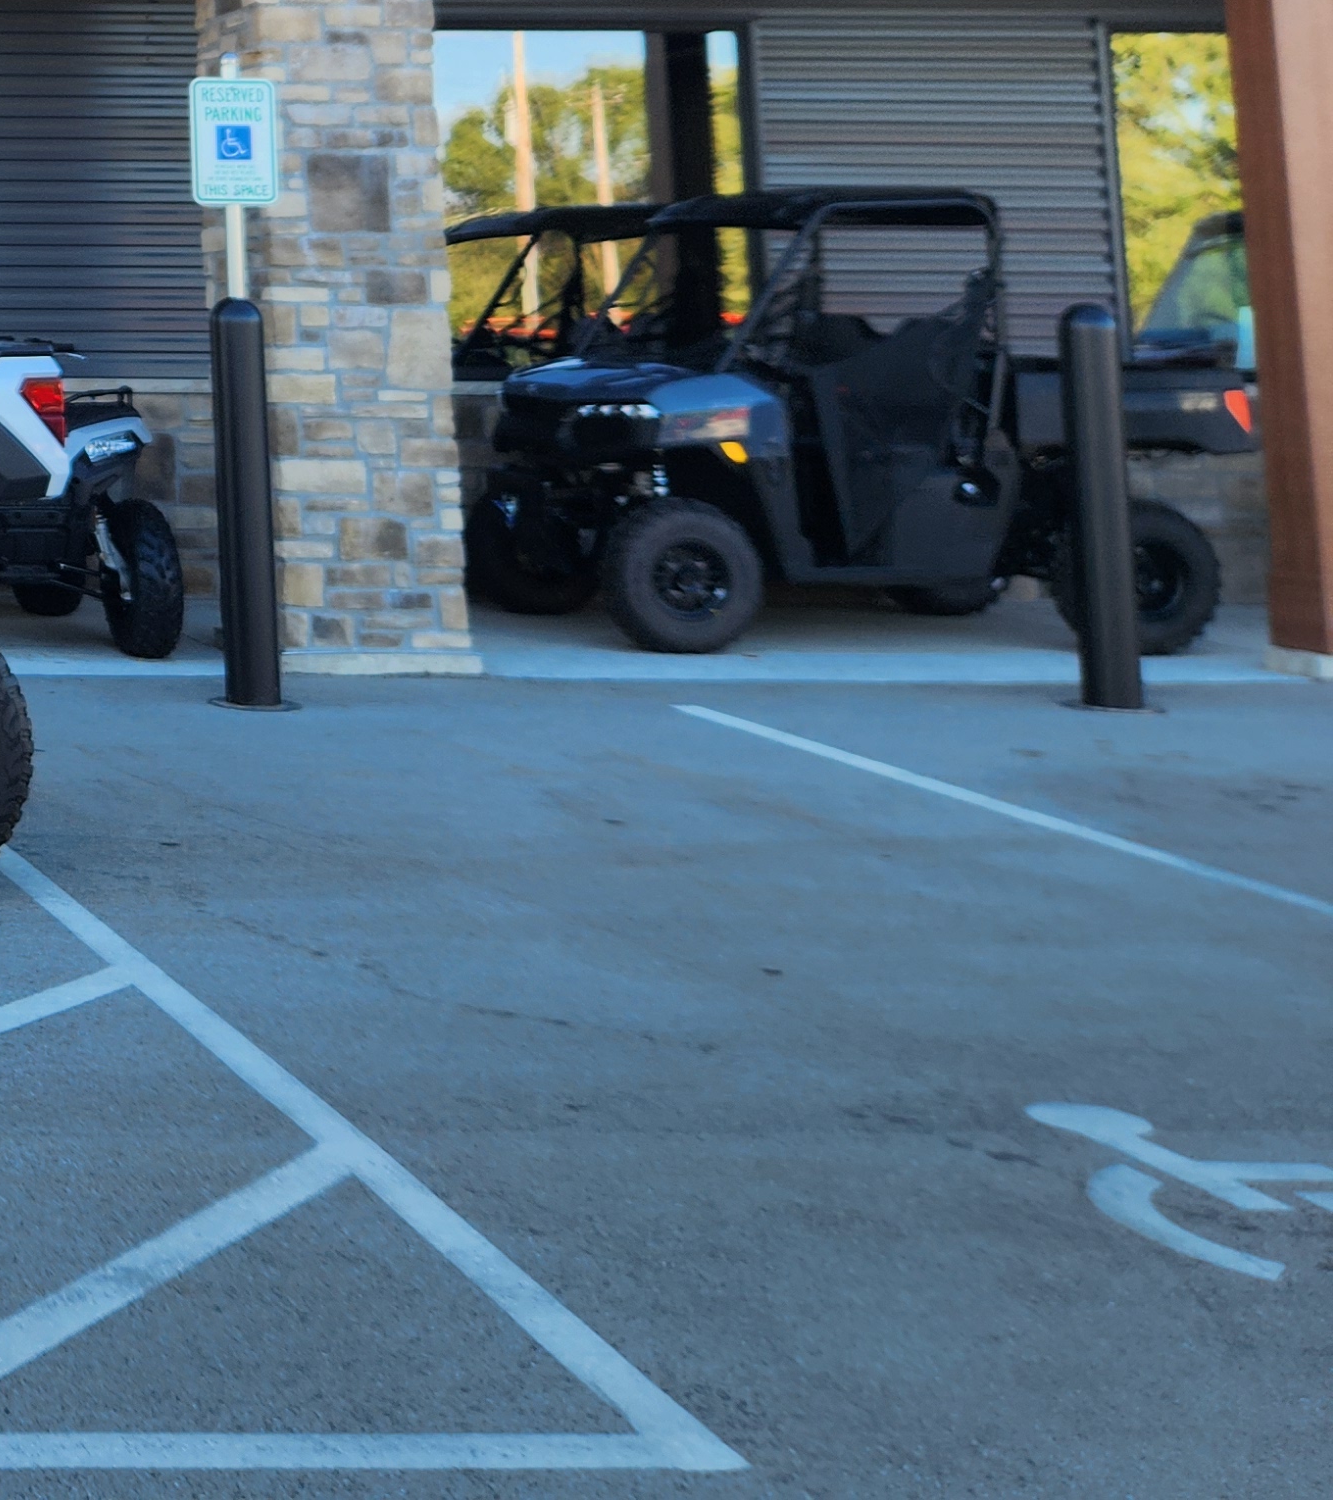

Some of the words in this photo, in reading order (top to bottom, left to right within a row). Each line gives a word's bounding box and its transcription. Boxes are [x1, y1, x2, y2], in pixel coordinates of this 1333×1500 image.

[201, 87, 264, 103] RESERVED
[204, 106, 262, 122] PARKING
[204, 184, 228, 196] THIS
[233, 184, 270, 196] SPACE
